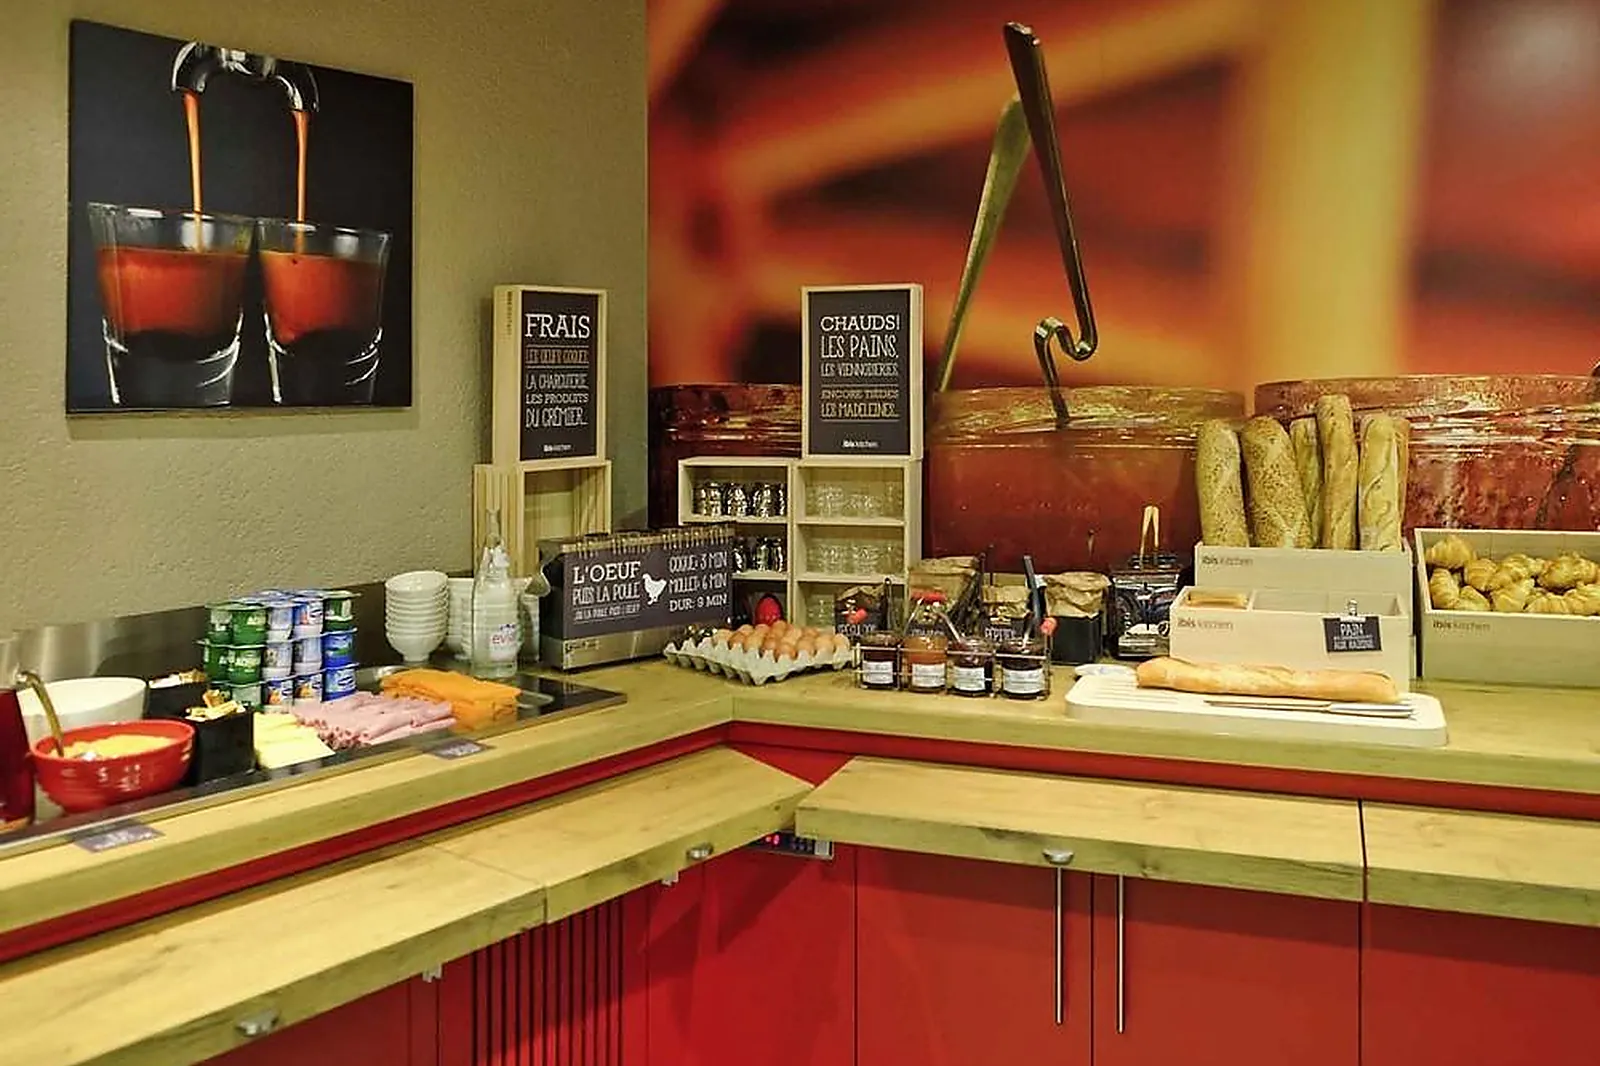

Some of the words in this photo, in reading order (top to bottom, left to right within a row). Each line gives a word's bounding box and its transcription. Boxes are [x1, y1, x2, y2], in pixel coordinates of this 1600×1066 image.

[525, 313, 590, 339] FRAIS
[820, 315, 900, 331] CHAUDS!
[820, 335, 844, 359] LES
[821, 362, 835, 377] LES
[525, 373, 537, 390] LA
[526, 393, 543, 404] LES
[544, 393, 589, 404] PRODUITS
[525, 408, 539, 428] DU
[821, 403, 836, 418] LES
[700, 553, 707, 570] 3
[709, 551, 727, 569] MIN
[1202, 555, 1218, 565] ibis
[573, 561, 641, 584] L'OEUF
[702, 574, 708, 590] 6
[709, 572, 727, 589] MIN
[572, 586, 595, 606] PUIS
[596, 585, 610, 602] LA
[612, 581, 641, 601] POULE
[706, 593, 727, 607] MIN
[1177, 616, 1196, 628] ibis
[1340, 623, 1364, 637] PAIN
[1432, 619, 1451, 630] ibis
